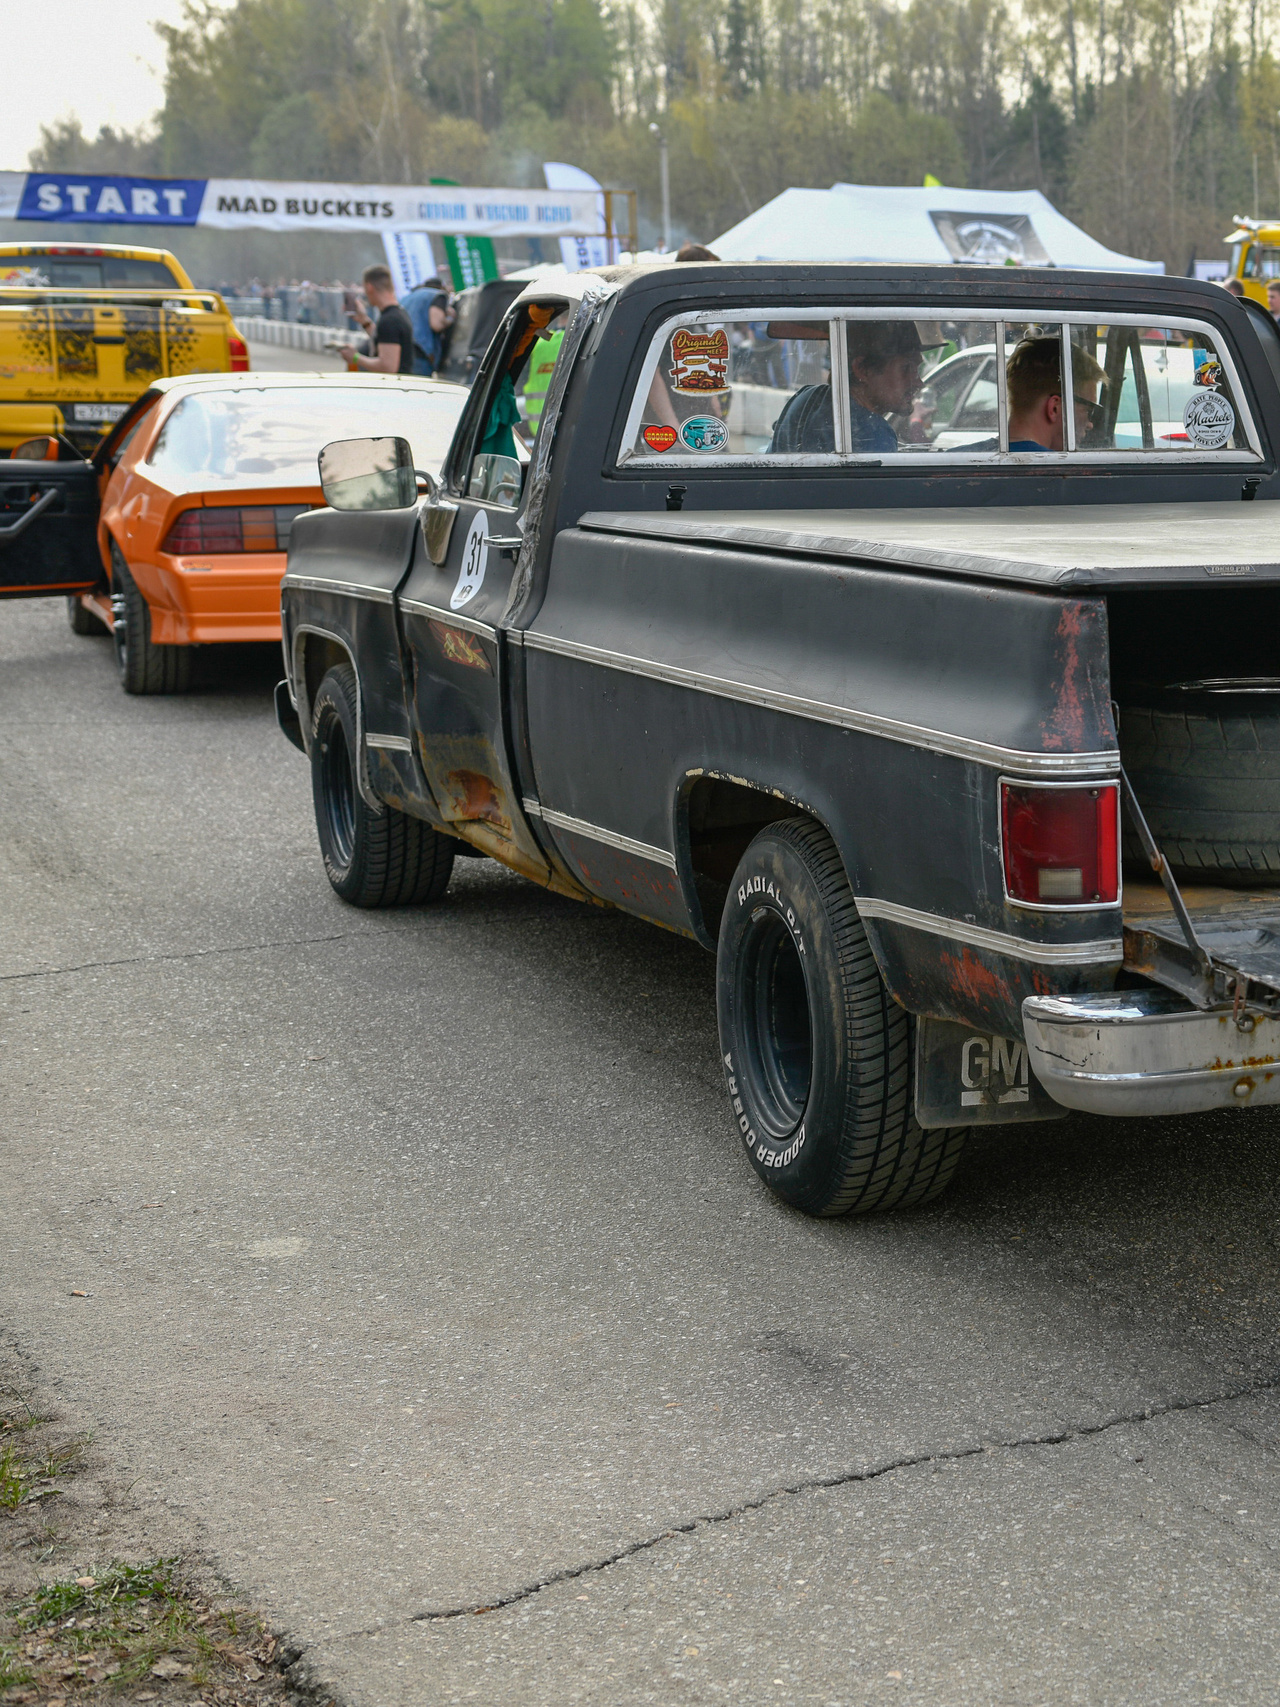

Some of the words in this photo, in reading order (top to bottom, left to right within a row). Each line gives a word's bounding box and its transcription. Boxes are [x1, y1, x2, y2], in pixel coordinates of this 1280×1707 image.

[37, 183, 187, 216] START
[217, 196, 277, 214] MAD
[286, 199, 394, 218] BUCKETS
[677, 332, 724, 352] Original
[1185, 410, 1233, 429] Machete
[467, 531, 484, 577] 31
[737, 875, 784, 908] RADIAL
[724, 1052, 757, 1149] COBRA
[756, 1124, 806, 1168] COOPER
